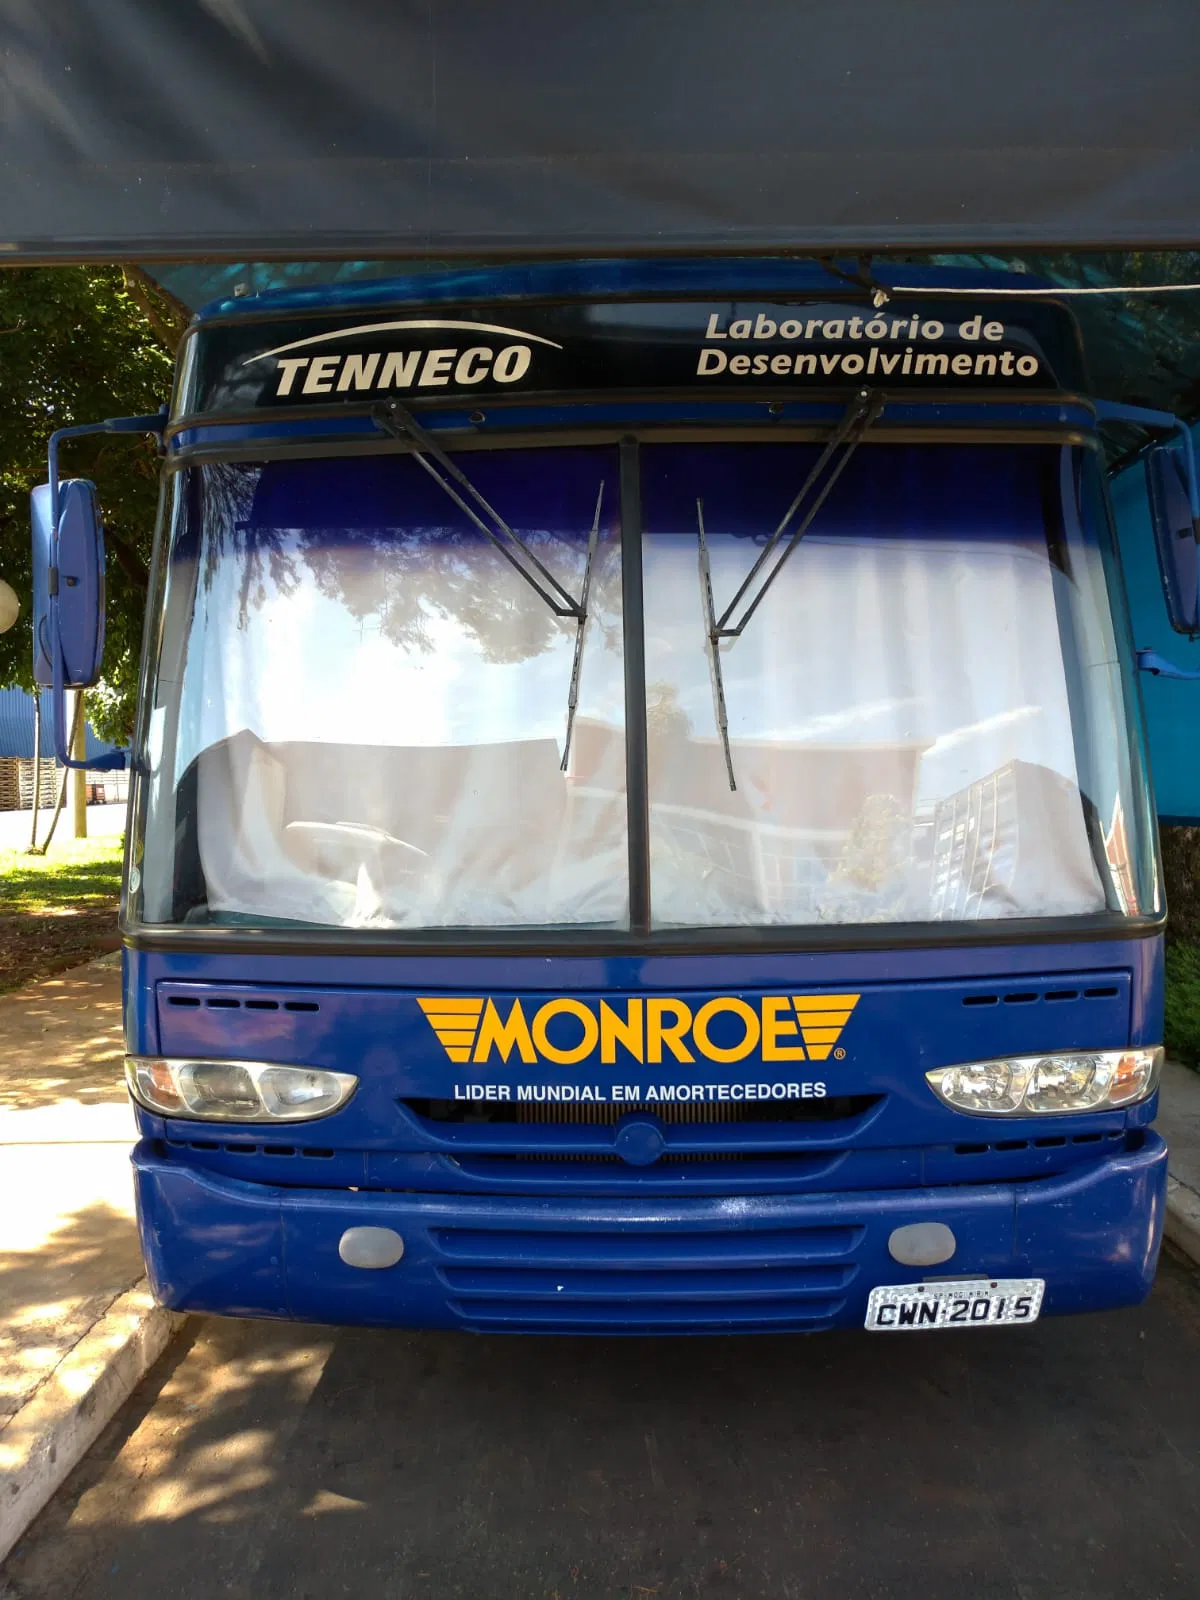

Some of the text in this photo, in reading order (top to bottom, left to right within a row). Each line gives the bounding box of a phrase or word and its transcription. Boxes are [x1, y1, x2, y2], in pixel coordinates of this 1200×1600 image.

[704, 311, 1005, 341] Laboratório de
[275, 344, 532, 397] TENNECO
[695, 347, 1040, 377] Desenvolvimento
[472, 995, 807, 1065] MONROE
[453, 1081, 828, 1102] LIDER MUNDIAL EM AMORTECEDORES
